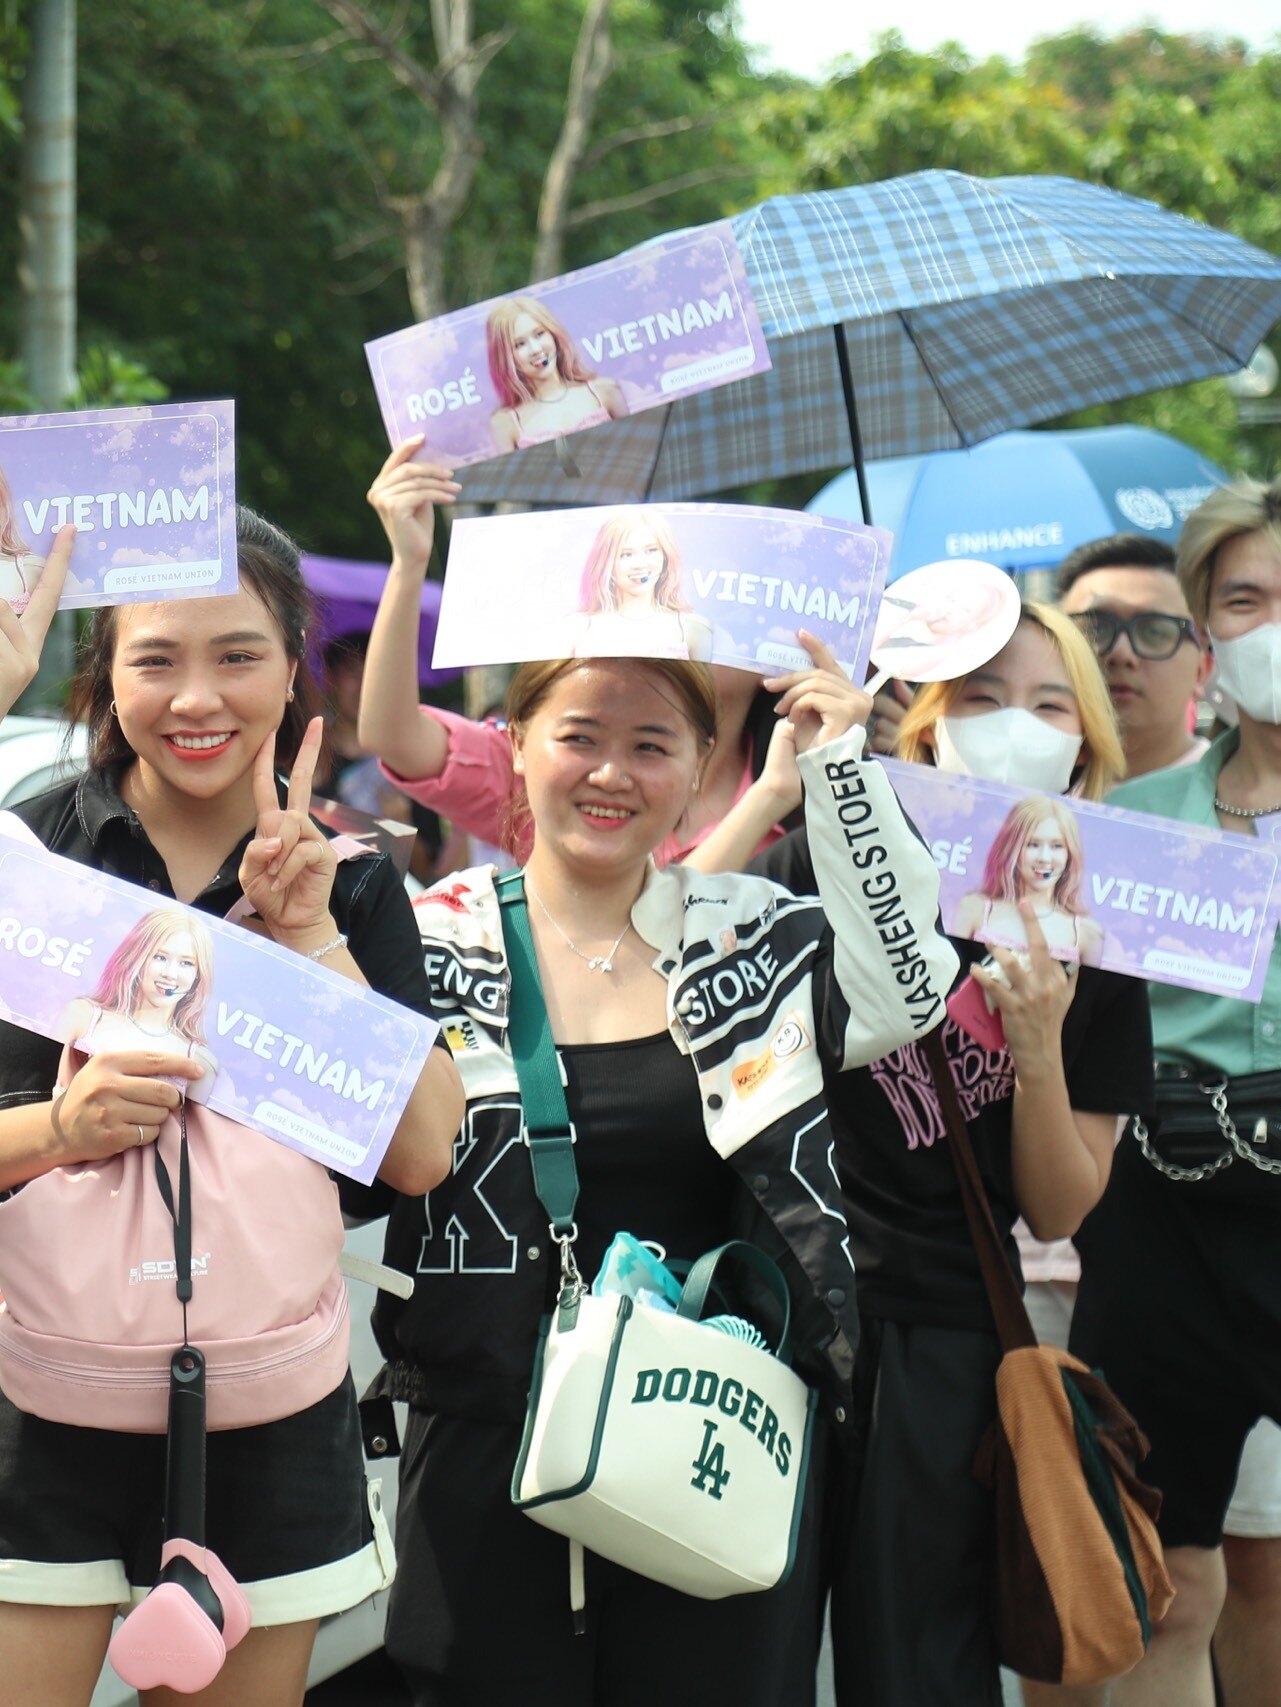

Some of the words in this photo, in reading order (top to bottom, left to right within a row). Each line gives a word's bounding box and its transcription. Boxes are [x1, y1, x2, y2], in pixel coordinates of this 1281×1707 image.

[408, 368, 481, 423] ROSÉ
[581, 291, 734, 364] VIETNAM
[22, 485, 209, 535] VIETNAM
[141, 571, 182, 583] VIETNAM
[184, 569, 214, 580] UNION
[692, 569, 860, 628] VIETNAM
[825, 758, 888, 869] STOER
[1091, 874, 1256, 937] VIETNAM
[680, 943, 780, 1027] STORE
[218, 1002, 386, 1111] VIETNAM
[289, 1121, 328, 1145] VIETNAM
[329, 1142, 358, 1160] UNION
[141, 1256, 207, 1275] SDN
[631, 1367, 792, 1476] DODGERS
[690, 1419, 731, 1500] LA
